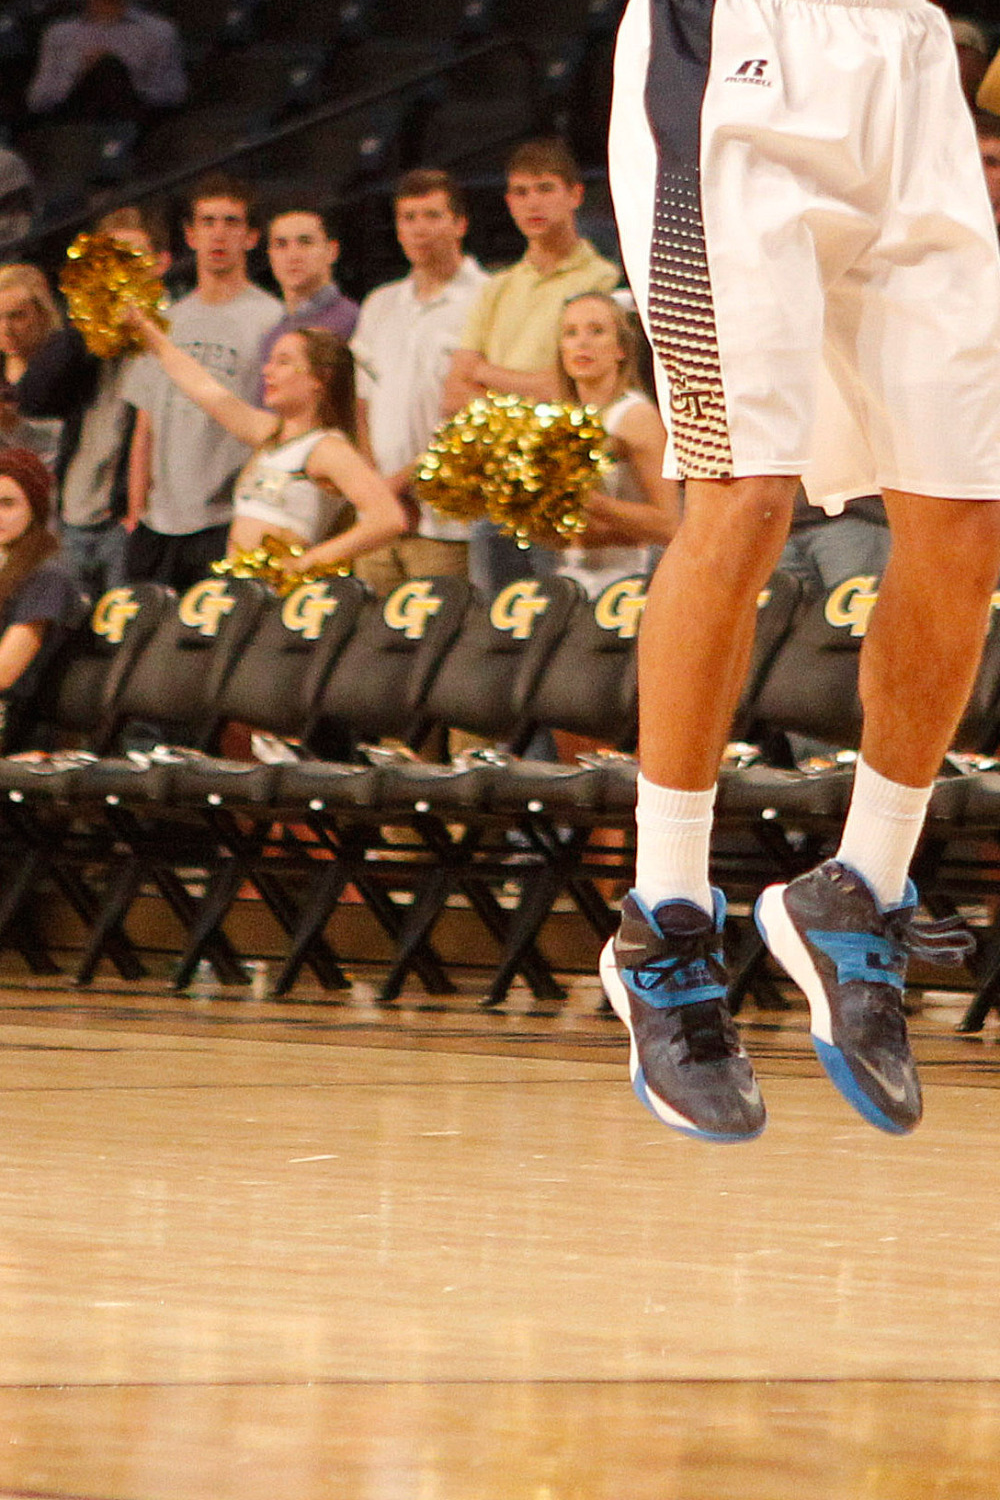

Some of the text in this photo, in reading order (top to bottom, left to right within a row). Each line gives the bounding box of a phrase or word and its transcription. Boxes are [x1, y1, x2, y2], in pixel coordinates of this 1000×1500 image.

[93, 587, 141, 644] GT
[179, 579, 236, 637] GT
[281, 581, 339, 640] GT
[384, 580, 443, 639] GT
[490, 580, 550, 639] GT
